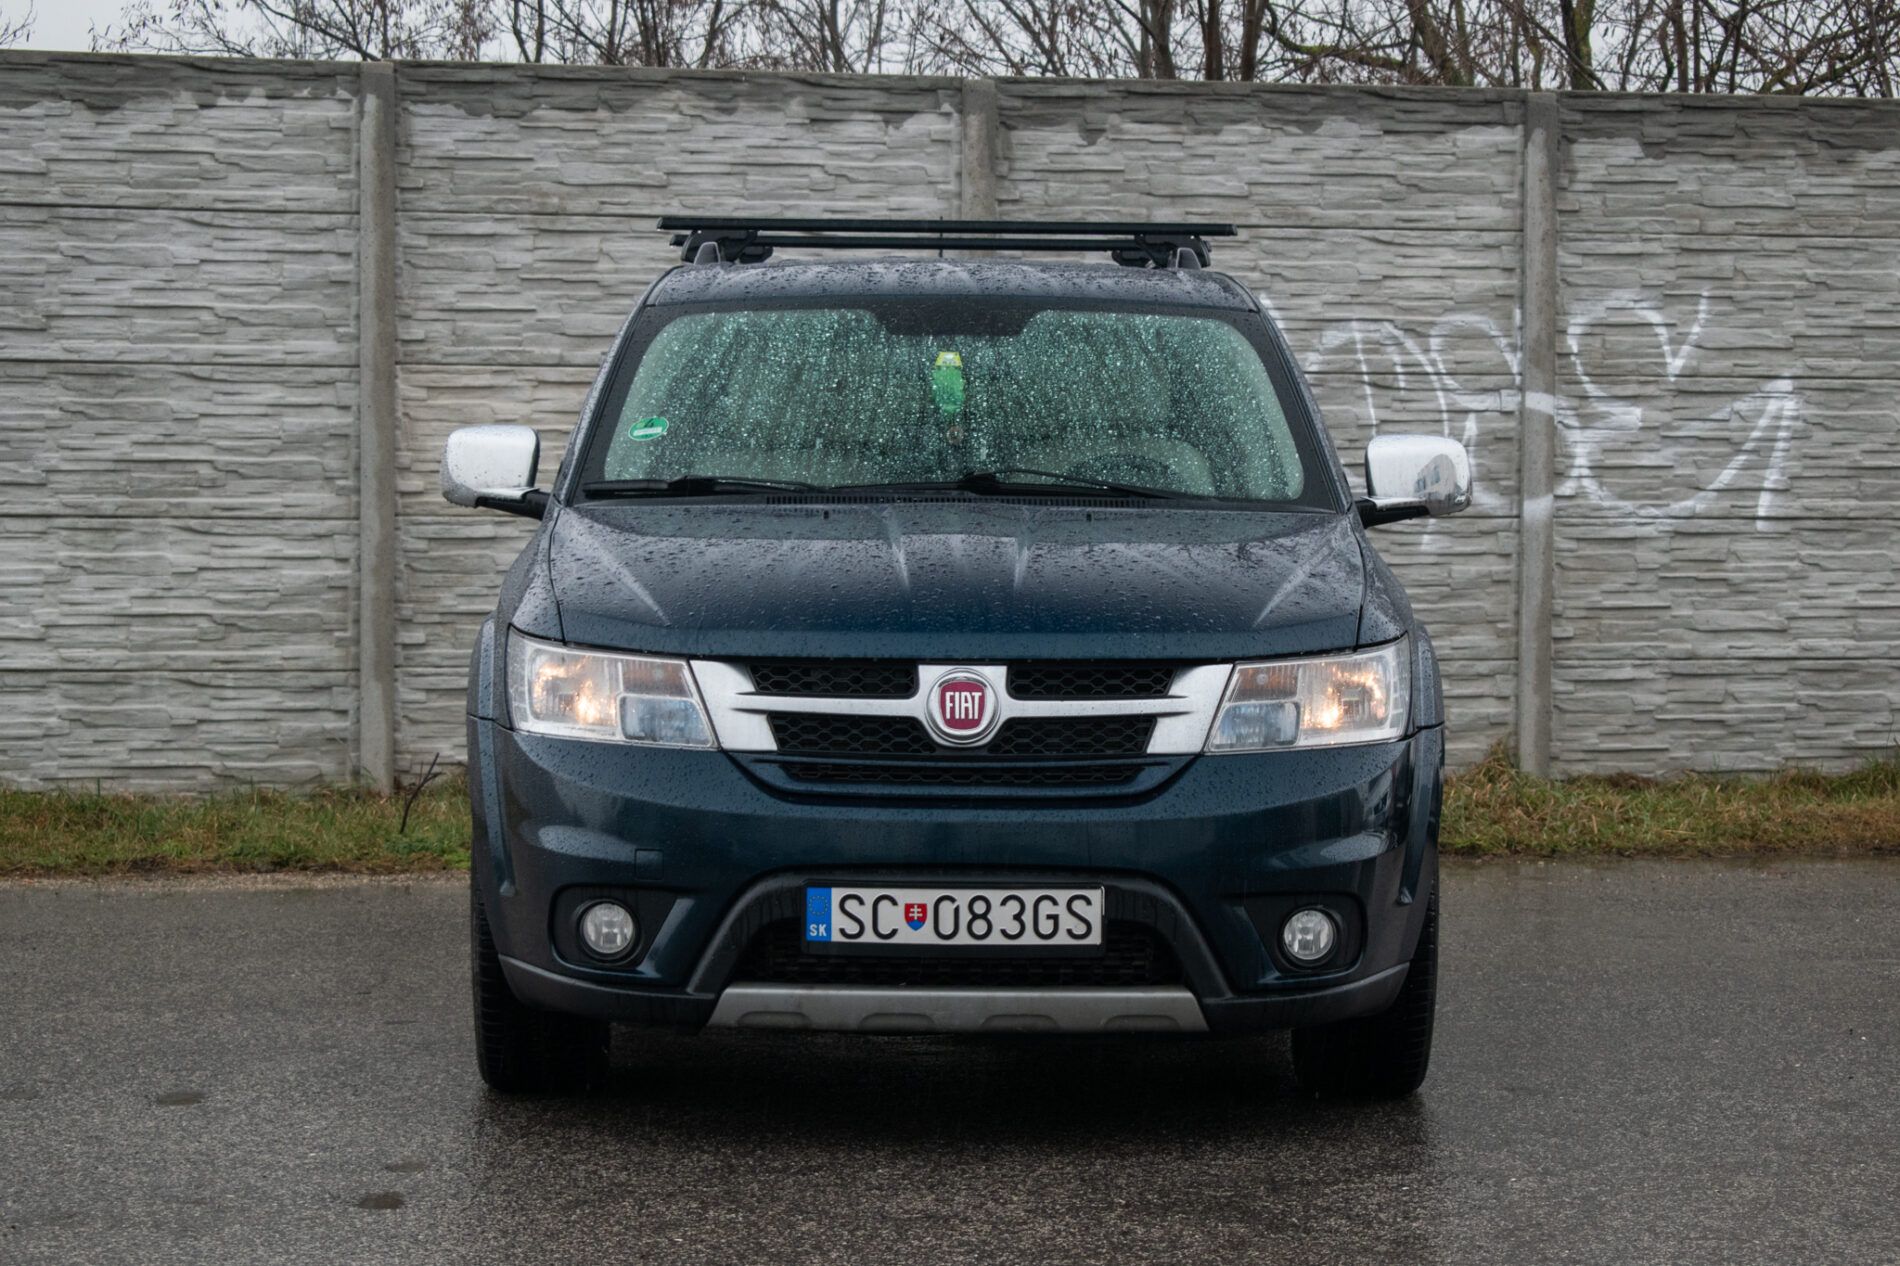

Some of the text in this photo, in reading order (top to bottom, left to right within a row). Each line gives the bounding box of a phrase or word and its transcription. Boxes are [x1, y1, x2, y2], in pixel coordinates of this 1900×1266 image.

[945, 691, 982, 720] FIAT
[809, 923, 827, 937] SK
[838, 893, 1093, 941] SC 083GS
